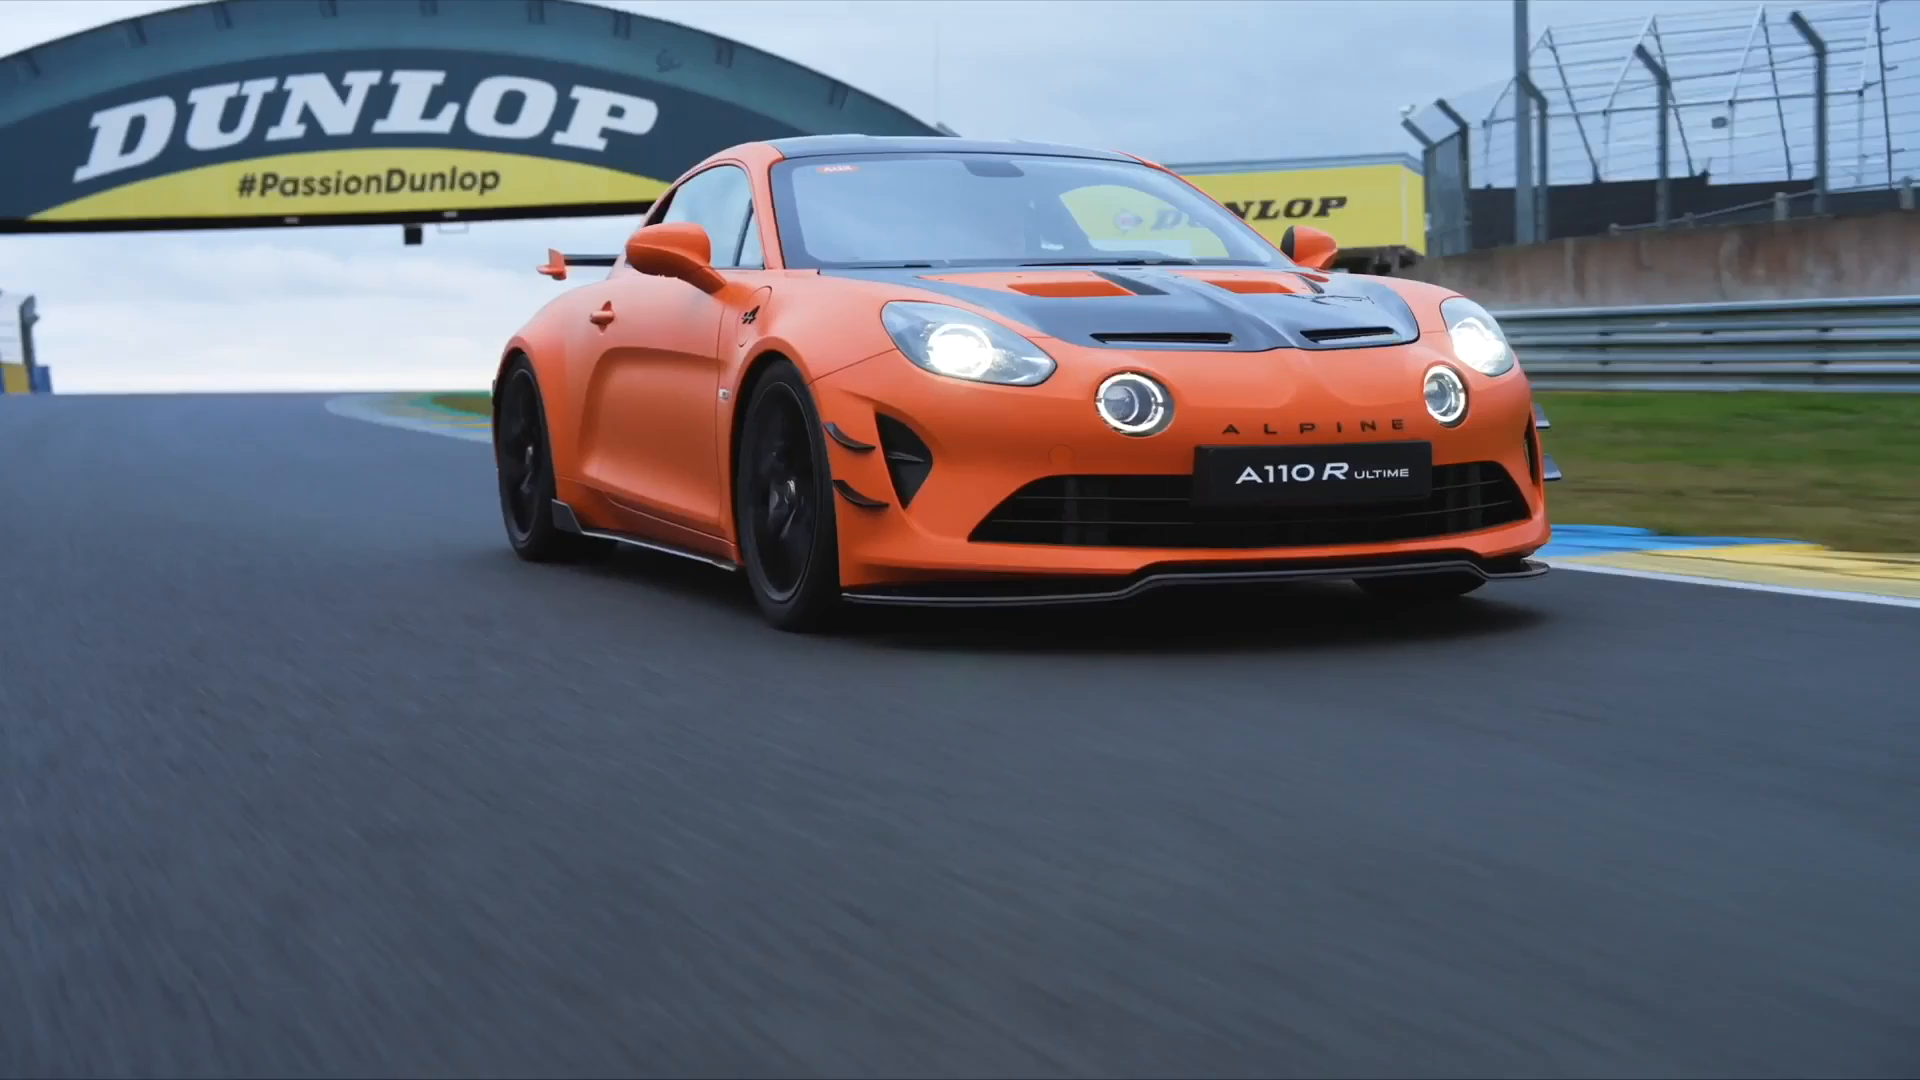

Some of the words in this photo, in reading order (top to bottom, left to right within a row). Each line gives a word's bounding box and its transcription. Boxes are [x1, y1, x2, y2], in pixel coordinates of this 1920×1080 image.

[73, 70, 658, 183] DUNLOP
[238, 166, 500, 198] #PassionDunlop
[1222, 419, 1404, 434] ALPINE
[1235, 464, 1315, 484] A110
[1322, 462, 1349, 480] R
[1354, 468, 1409, 479] ULTIME
